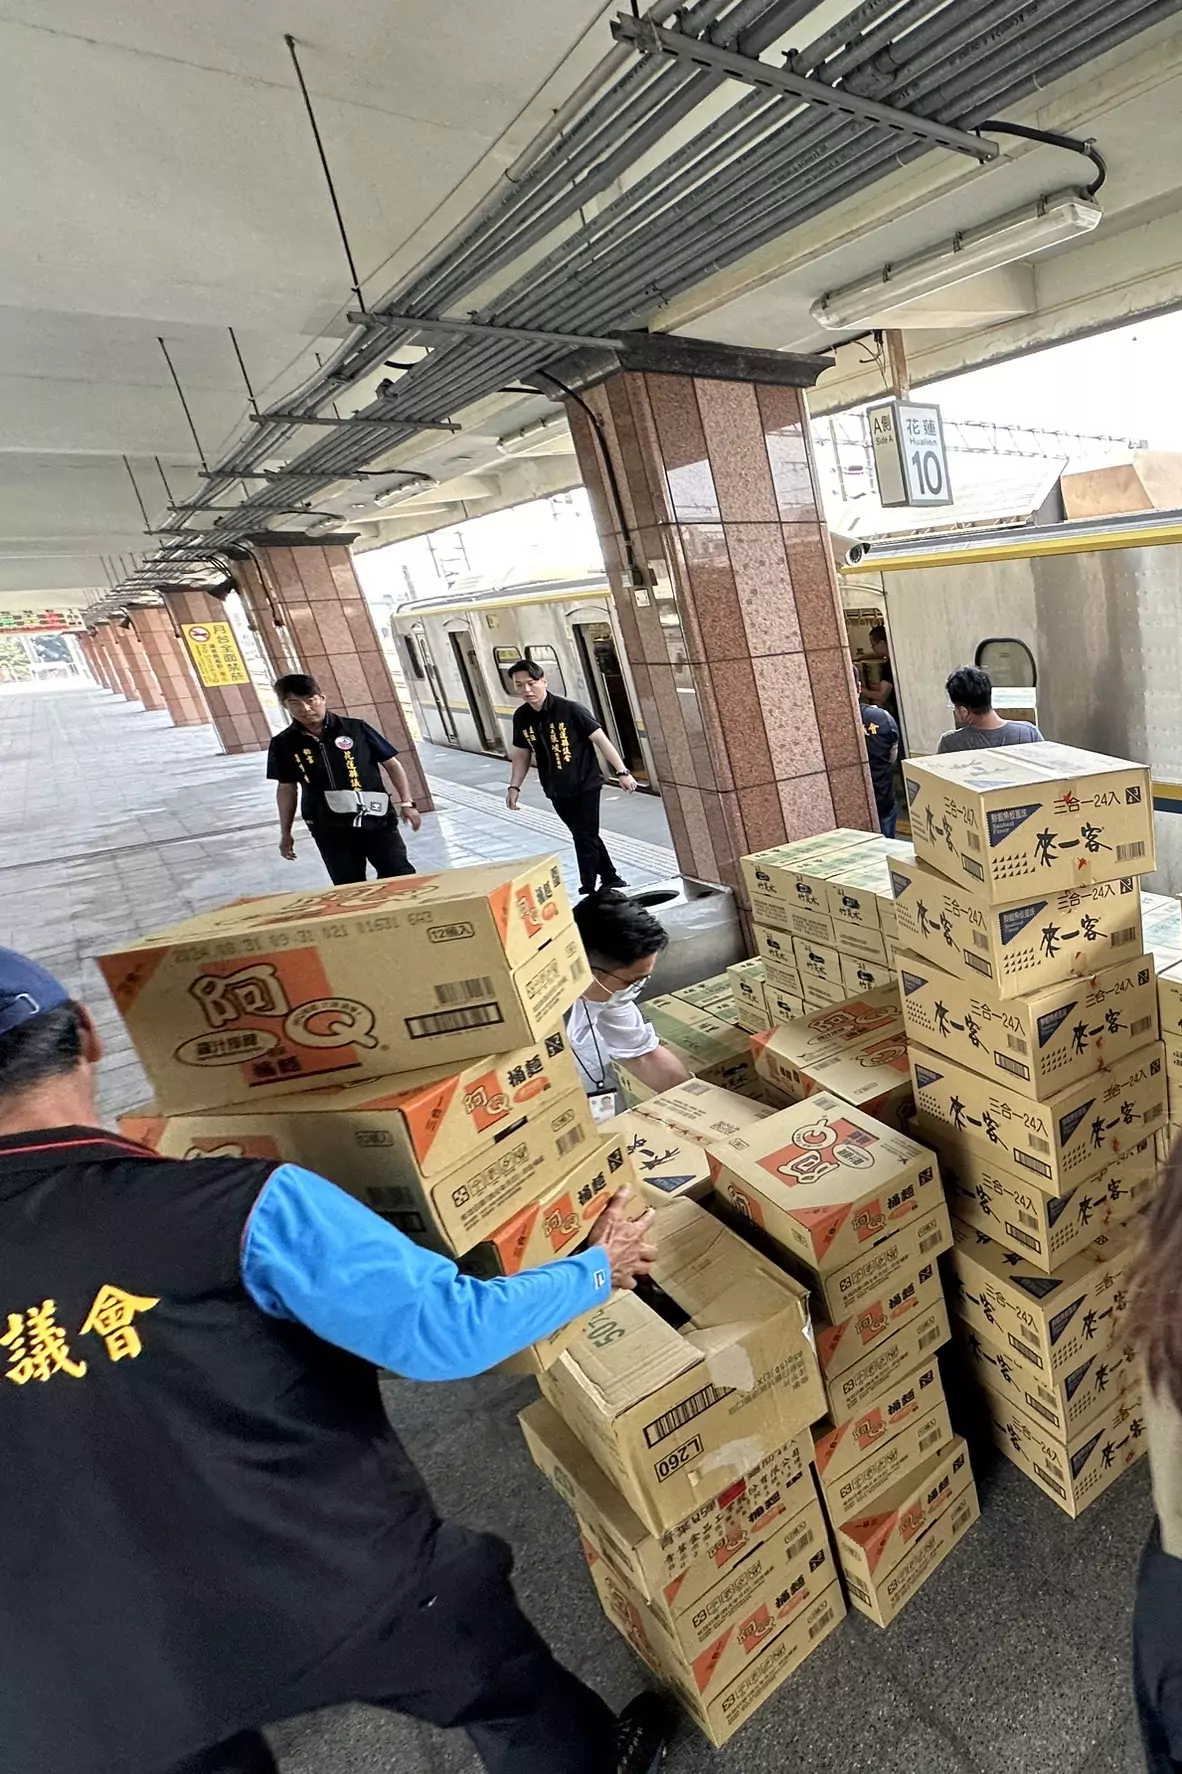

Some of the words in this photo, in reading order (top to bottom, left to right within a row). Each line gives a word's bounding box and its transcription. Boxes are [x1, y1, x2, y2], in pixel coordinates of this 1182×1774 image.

[874, 414, 891, 434] A側
[876, 436, 888, 445] Side
[906, 418, 936, 436] 花蓮
[910, 437, 937, 446] Hualien
[912, 450, 943, 495] 10
[943, 796, 979, 830] 三合一24入
[1053, 791, 1121, 816] 三合一24入
[925, 804, 960, 858] 來一客
[1034, 821, 1113, 868] 來一客
[943, 894, 987, 931] 三合一24入
[1057, 884, 1116, 912] 三合一24入
[916, 899, 960, 952] 來一客
[1040, 913, 1109, 959] 來一客
[188, 962, 380, 1049] 阿Q
[1085, 977, 1135, 1008] 三合一24入
[934, 999, 990, 1055] 來一客
[970, 998, 1026, 1036] 三合一24入
[1072, 1008, 1128, 1055] 來一客
[508, 1053, 545, 1088] 桶麵
[1103, 1068, 1148, 1104] 三合一24入
[463, 1084, 513, 1115] 阿Q
[988, 1097, 1049, 1138] 三合一24入
[950, 1095, 1009, 1151] 來一客
[1091, 1100, 1141, 1150] 來一客
[777, 1118, 840, 1184] 阿Q
[577, 1171, 607, 1206] 桶麵
[887, 1184, 915, 1210] 桶麵
[982, 1172, 1039, 1215] 三合一24入
[1077, 1178, 1129, 1227] 來一客
[543, 1207, 582, 1239] 阿Q
[851, 1209, 887, 1232] 阿Q
[888, 1282, 915, 1310] 桶麵
[985, 1282, 1039, 1334] 三合一24入
[1081, 1289, 1130, 1341] 來一客
[0, 1284, 162, 1385] 議會
[967, 1331, 1021, 1394] 來一客
[887, 1388, 916, 1416] 桶麵
[991, 1417, 1030, 1462] 一客
[1011, 1415, 1063, 1469] 三合一24入
[1100, 1417, 1148, 1470] 來一客
[659, 1442, 701, 1477] L260
[927, 1475, 950, 1504] 桶麵
[775, 1573, 806, 1609] 桶麵
